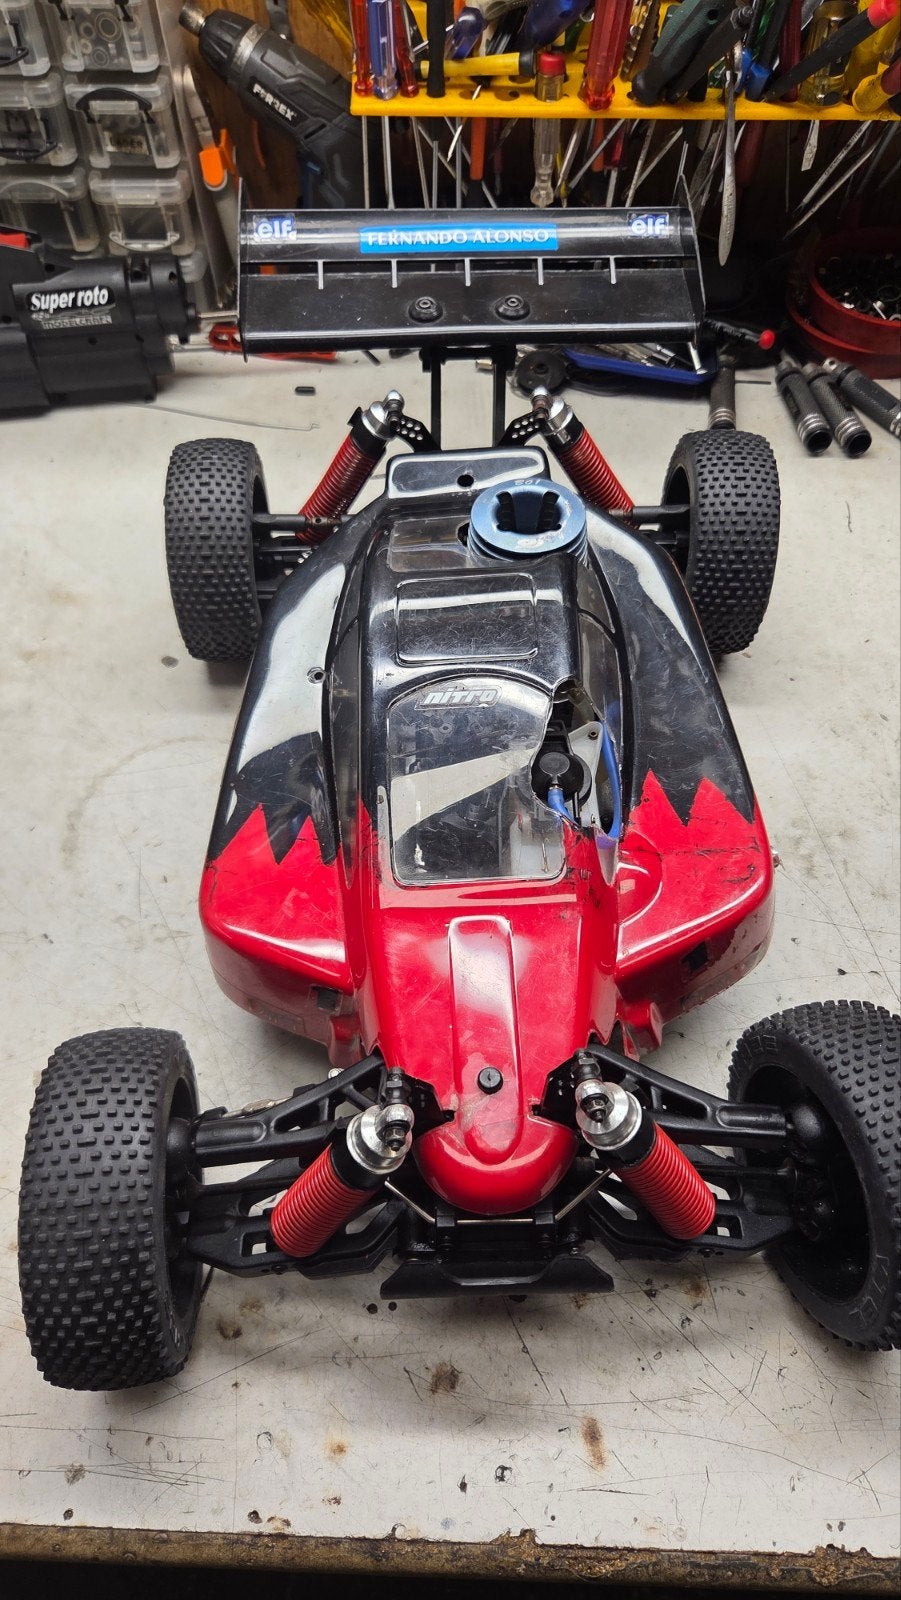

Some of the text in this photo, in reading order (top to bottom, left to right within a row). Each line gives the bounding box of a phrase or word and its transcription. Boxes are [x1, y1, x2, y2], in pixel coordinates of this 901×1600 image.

[257, 219, 292, 238] elf
[631, 217, 665, 235] elf
[367, 228, 550, 246] FERNANDO ALONSO
[30, 285, 109, 314] Super roto
